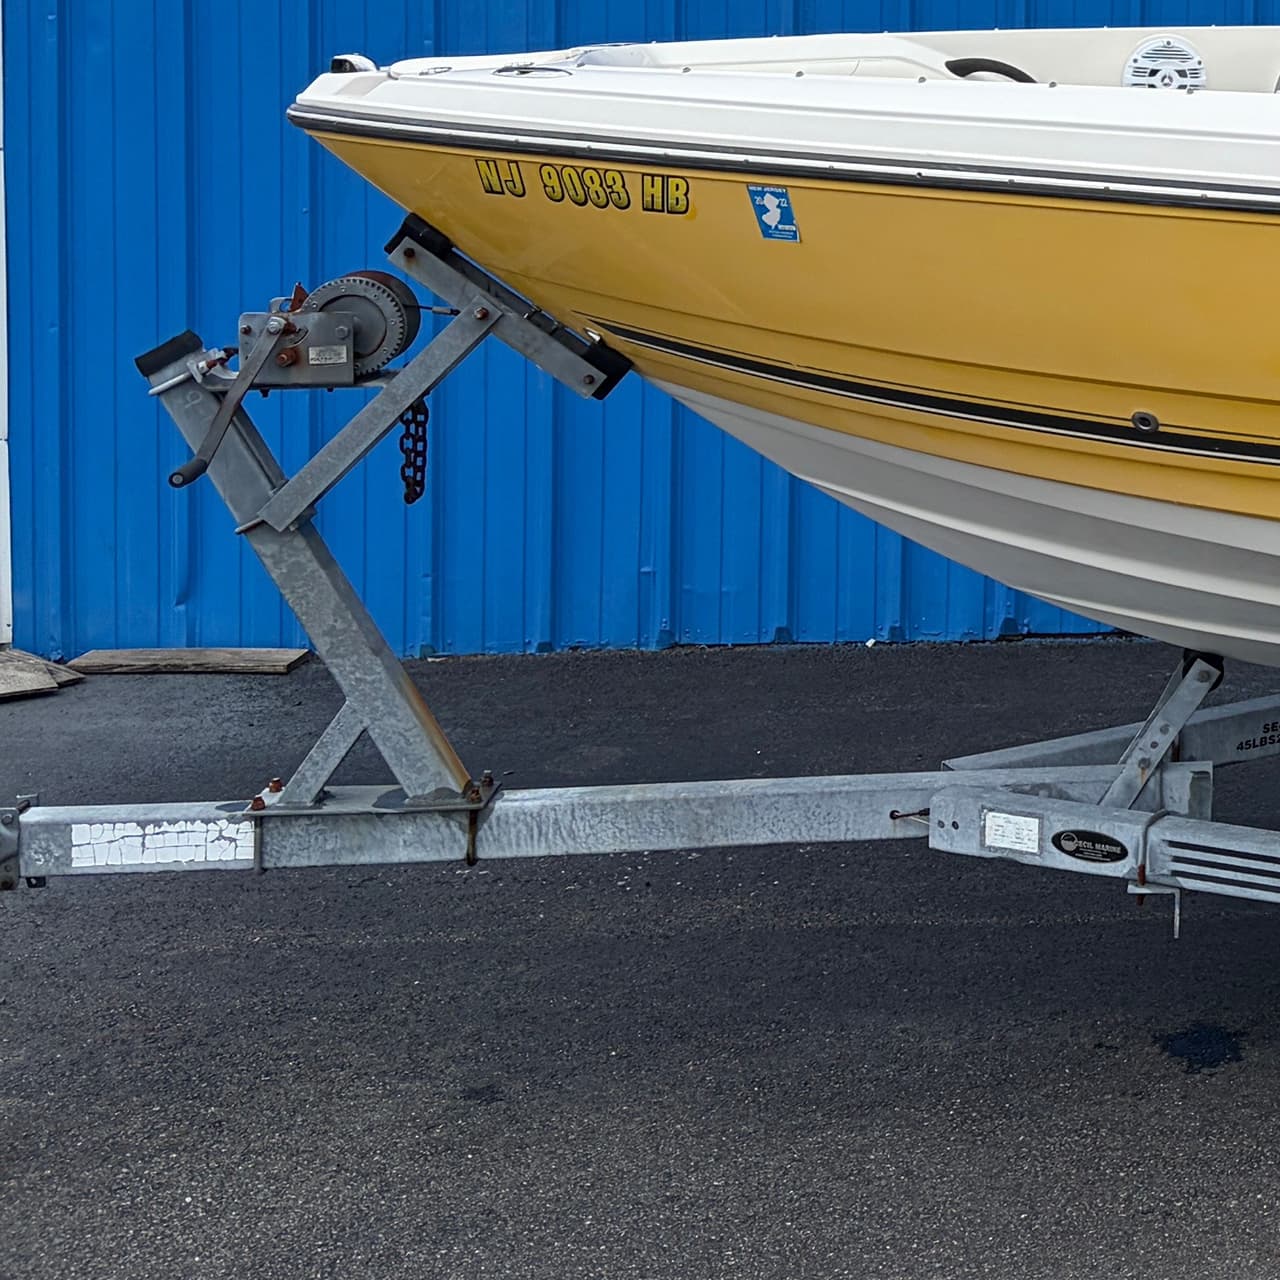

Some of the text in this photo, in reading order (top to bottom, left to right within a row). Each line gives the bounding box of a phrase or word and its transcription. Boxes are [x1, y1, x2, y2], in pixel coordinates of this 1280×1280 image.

[474, 159, 690, 215] NJ 9083 HB
